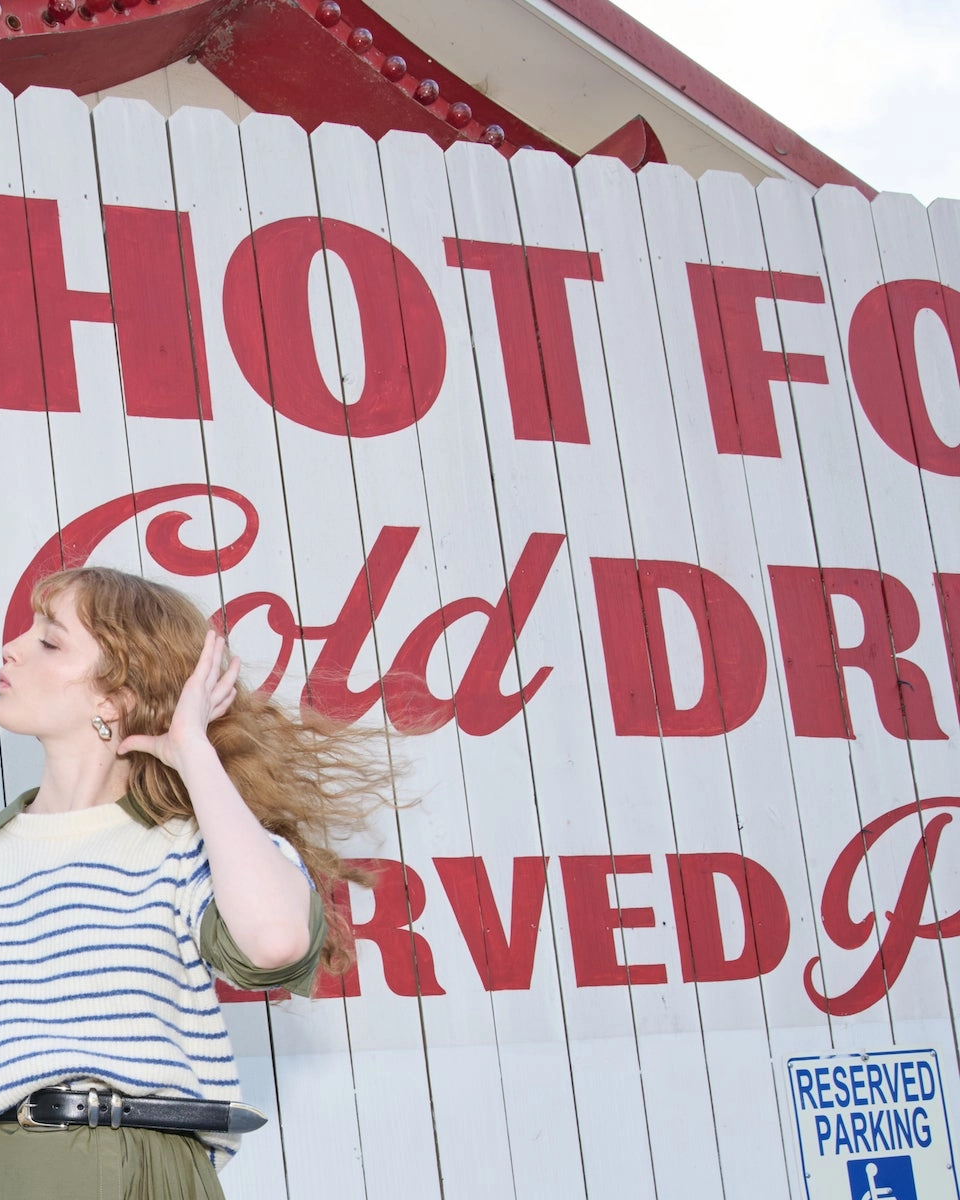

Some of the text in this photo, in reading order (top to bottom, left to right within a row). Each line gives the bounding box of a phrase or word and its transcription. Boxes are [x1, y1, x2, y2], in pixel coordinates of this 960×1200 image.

[2, 483, 566, 737] Cold
[215, 852, 791, 1004] RVED
[795, 1060, 937, 1111] RESERVED
[814, 1106, 933, 1156] PARKING
